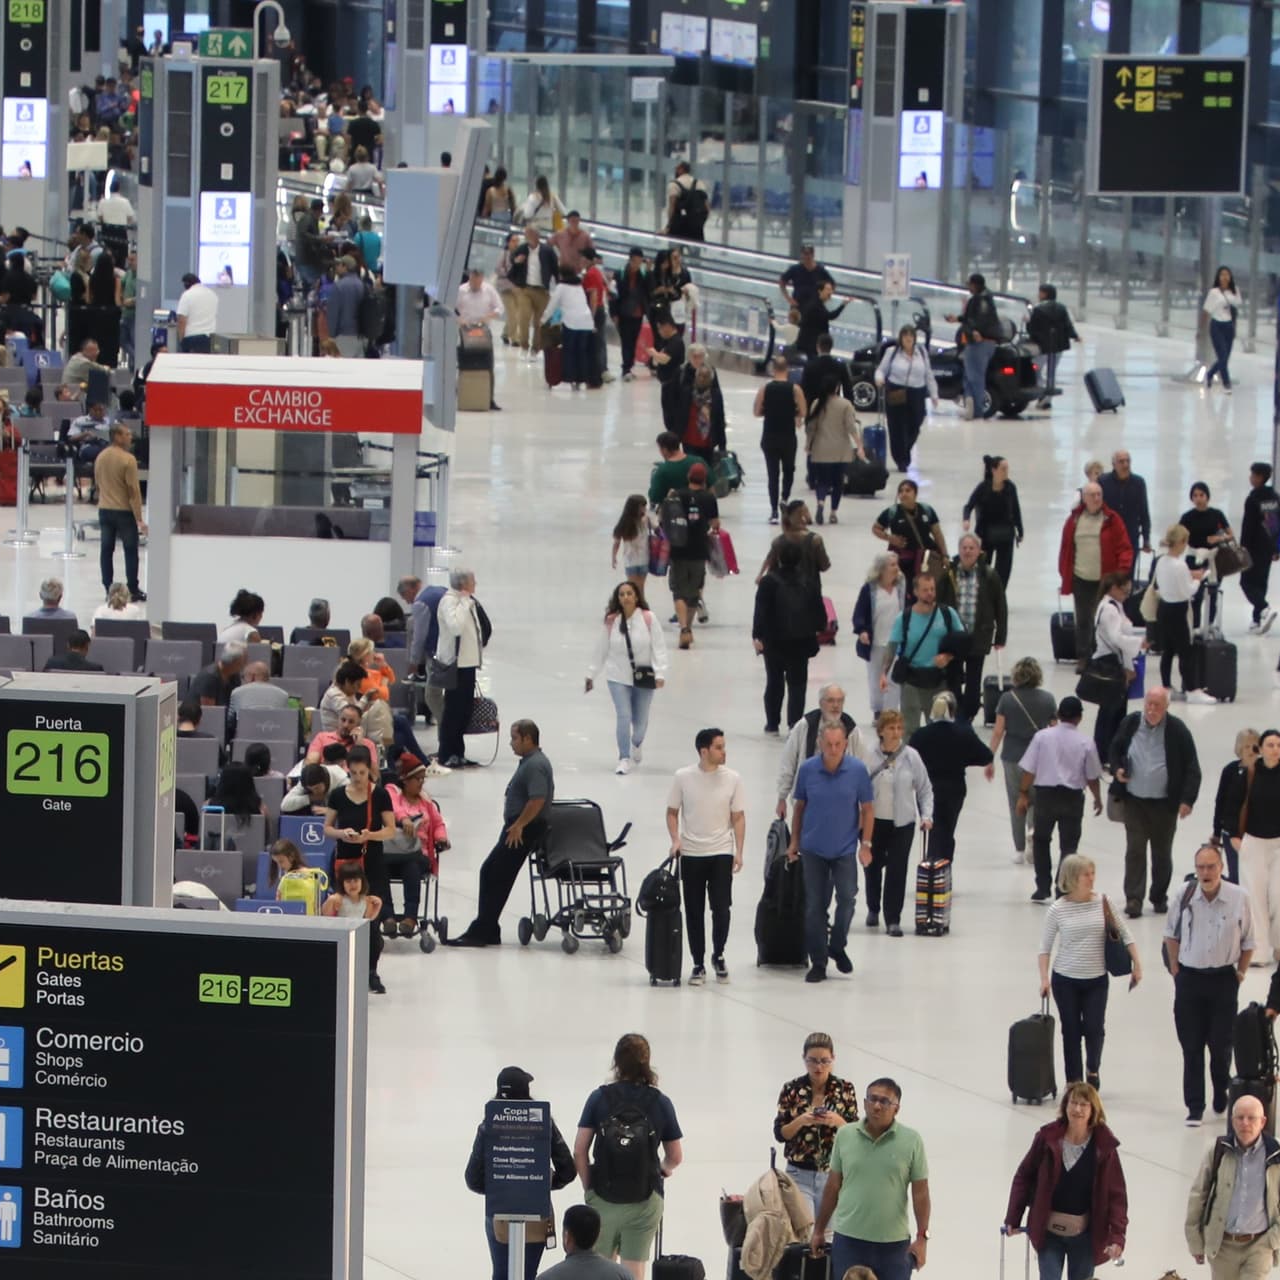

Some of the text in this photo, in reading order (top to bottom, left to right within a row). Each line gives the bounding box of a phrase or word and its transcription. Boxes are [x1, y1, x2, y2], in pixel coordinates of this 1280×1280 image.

[10, 2, 41, 18] 218
[209, 81, 246, 98] 217
[248, 389, 322, 408] CAMBIO
[233, 407, 333, 426] EXCHANGE
[35, 715, 82, 731] Puerta
[13, 741, 102, 785] 216
[42, 799, 72, 812] Gate
[36, 971, 82, 988] Gates
[38, 947, 124, 972] Puertas
[201, 979, 239, 998] 216
[252, 982, 289, 1002] 225
[36, 990, 85, 1007] Portas
[36, 1027, 144, 1053] Comercio
[35, 1052, 84, 1070] Shops
[35, 1070, 108, 1088] Comércio
[493, 1114, 528, 1122] Airlines
[503, 1107, 528, 1116] Copa
[35, 1107, 186, 1136] Restaurantes
[34, 1132, 126, 1151] Restaurants
[34, 1151, 199, 1175] Praça de Alimentação
[34, 1187, 105, 1211] Baños
[33, 1211, 115, 1230] Bathrooms
[33, 1230, 99, 1247] Sanitário
